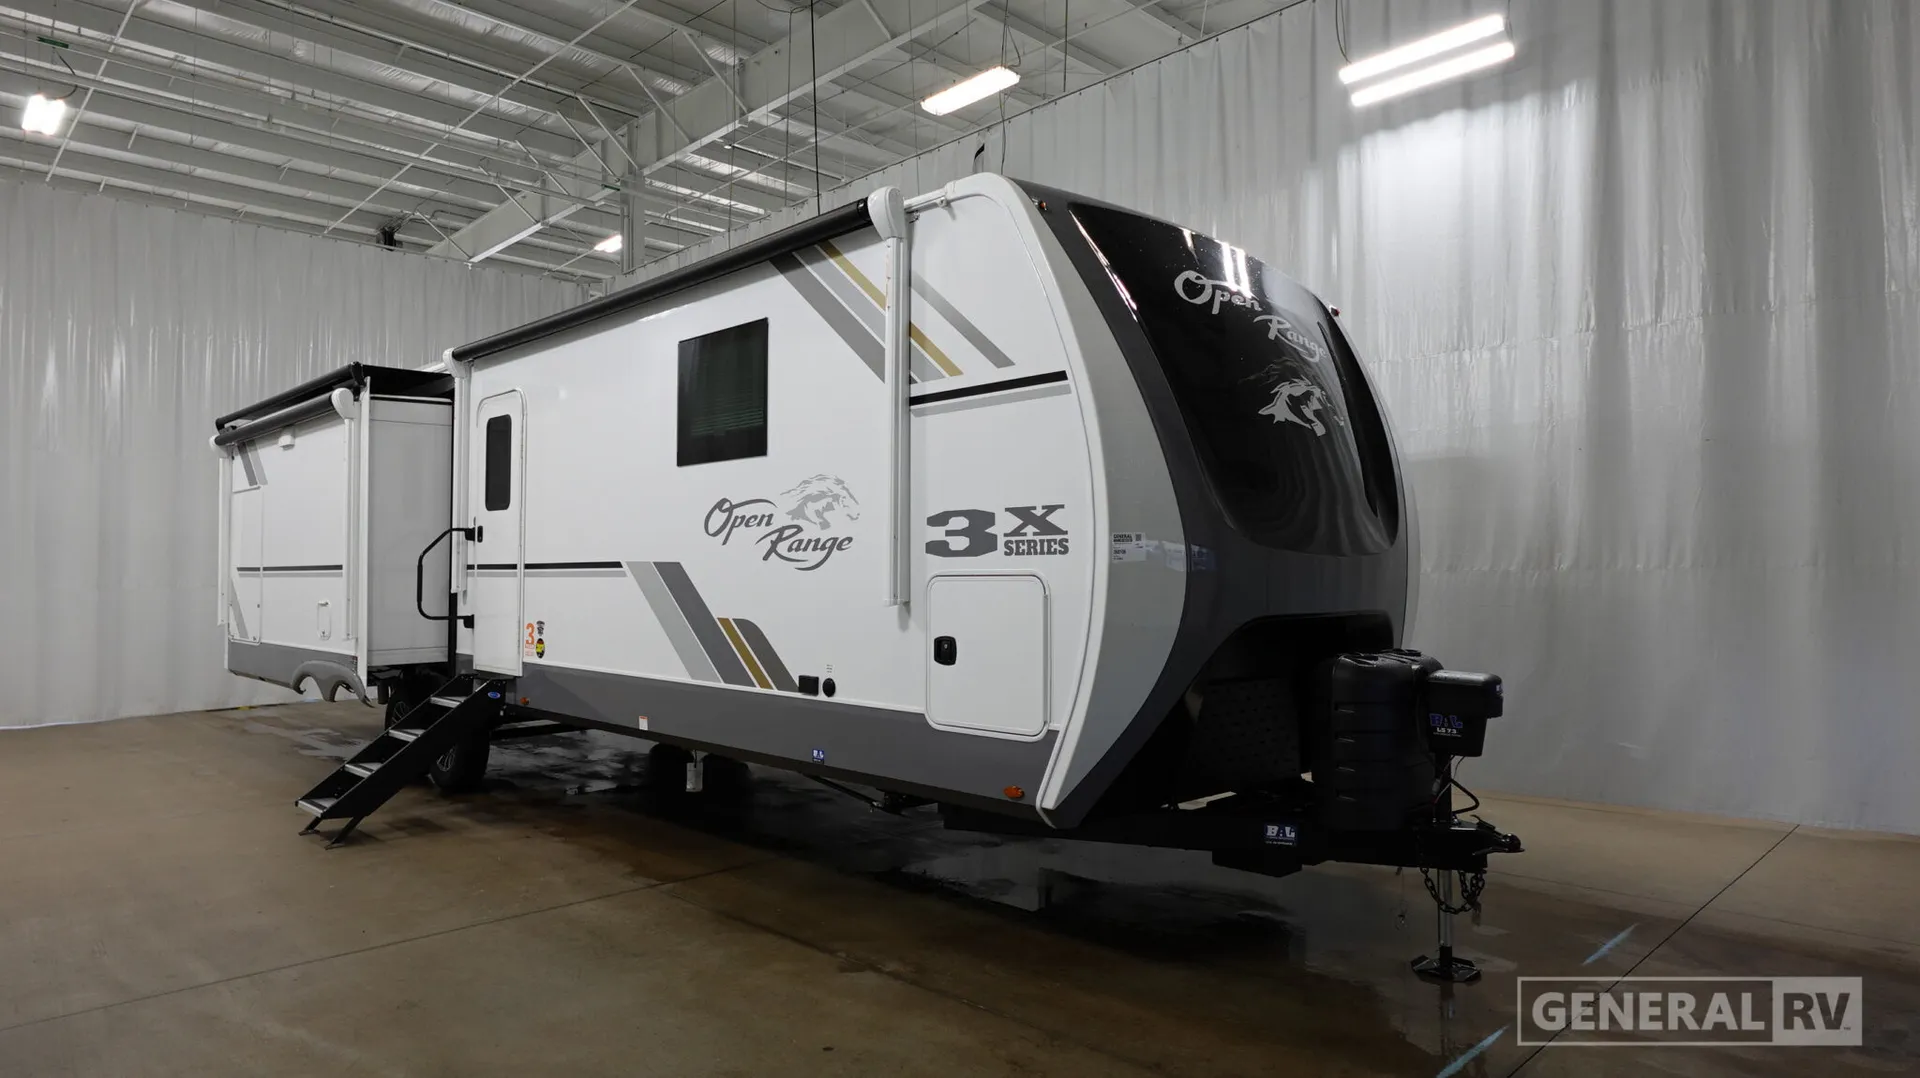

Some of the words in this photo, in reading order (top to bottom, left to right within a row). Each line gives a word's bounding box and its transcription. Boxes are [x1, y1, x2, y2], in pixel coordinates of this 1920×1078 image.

[1174, 270, 1263, 314] Open
[1253, 314, 1328, 362] Range
[703, 497, 778, 546] Open
[754, 524, 853, 571] Range
[1003, 537, 1070, 557] SERIES
